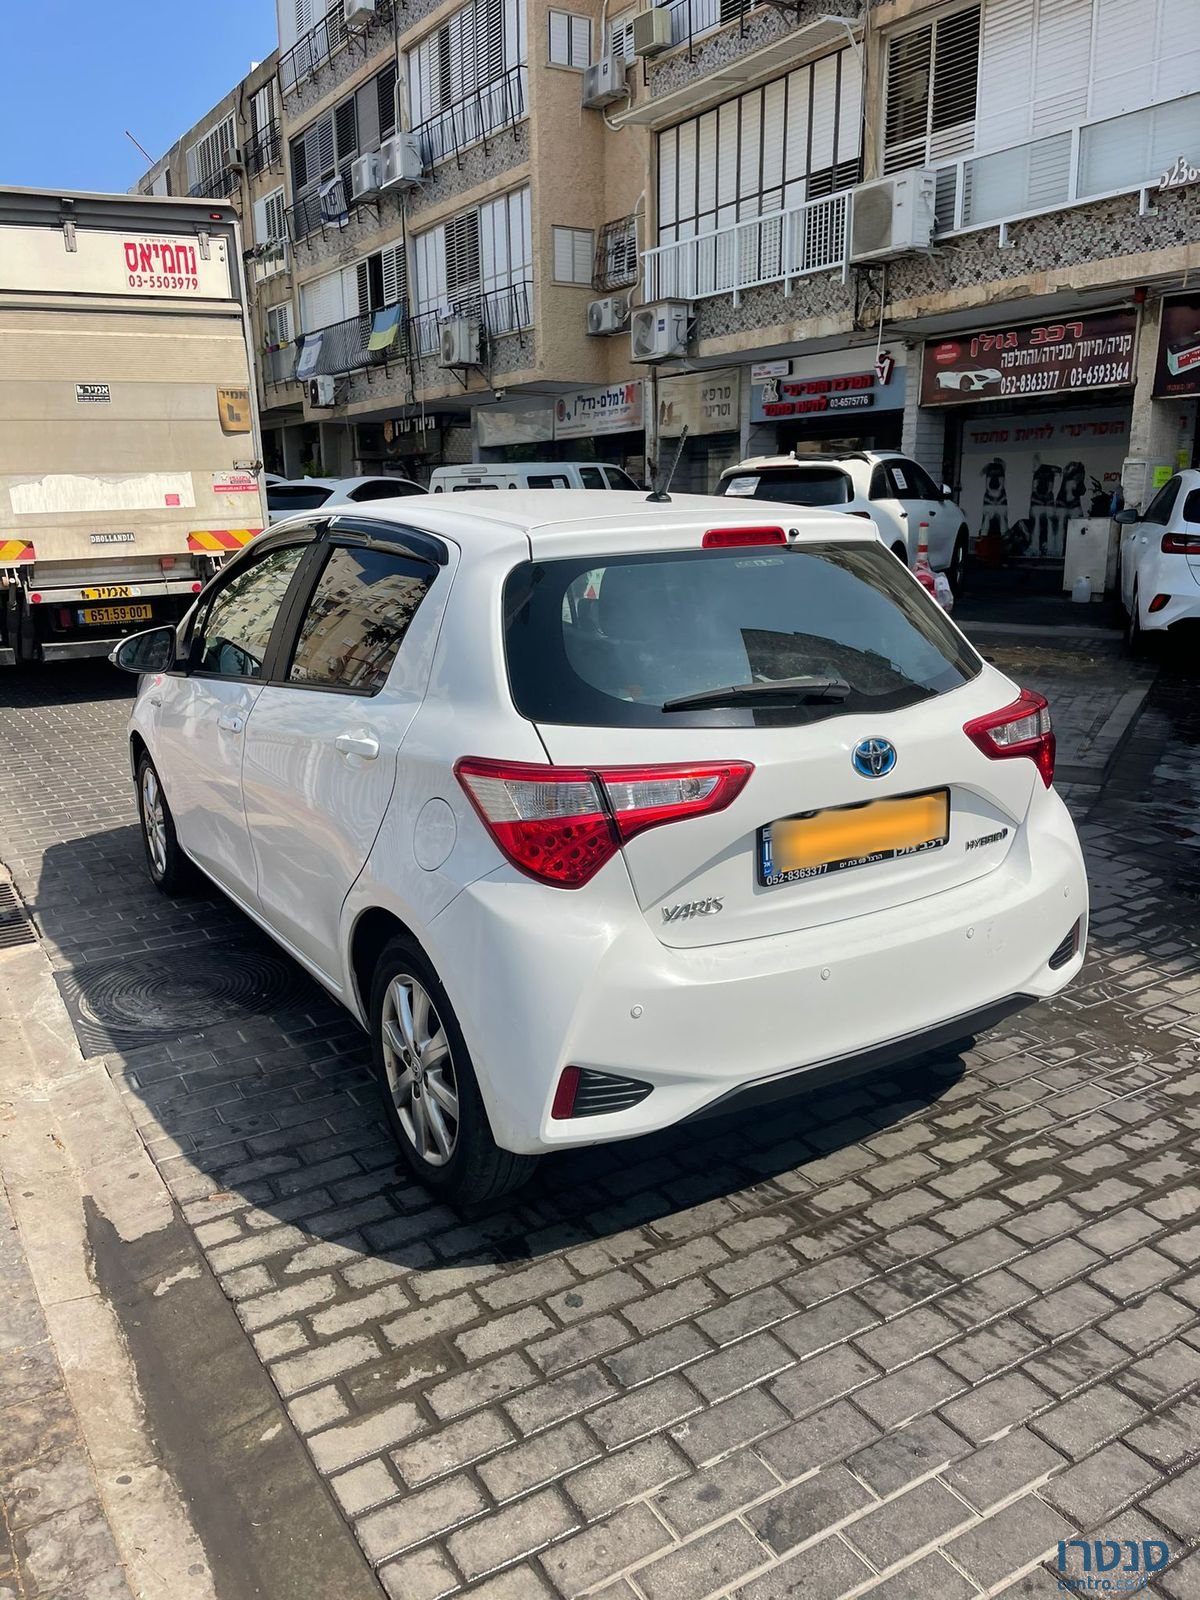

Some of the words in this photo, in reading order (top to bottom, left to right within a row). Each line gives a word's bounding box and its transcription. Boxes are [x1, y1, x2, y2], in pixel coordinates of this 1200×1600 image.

[124, 242, 197, 274] נחמיאס
[129, 275, 198, 290] 03-5503979
[1029, 321, 1083, 345] רכב
[970, 332, 1018, 358] גולן
[1000, 370, 1059, 394] 052-8363377
[1070, 362, 1129, 386] 03-6593364
[84, 385, 109, 394] אמיר
[830, 395, 869, 408] 03-6575776
[970, 428, 1008, 444] מחמד
[1015, 422, 1054, 442] לחיות
[91, 533, 135, 542] DHOLLANDIA
[93, 586, 129, 598] אמיר
[920, 838, 944, 850] רכב
[965, 831, 1003, 851] HYBRID
[662, 895, 725, 924] YARIS
